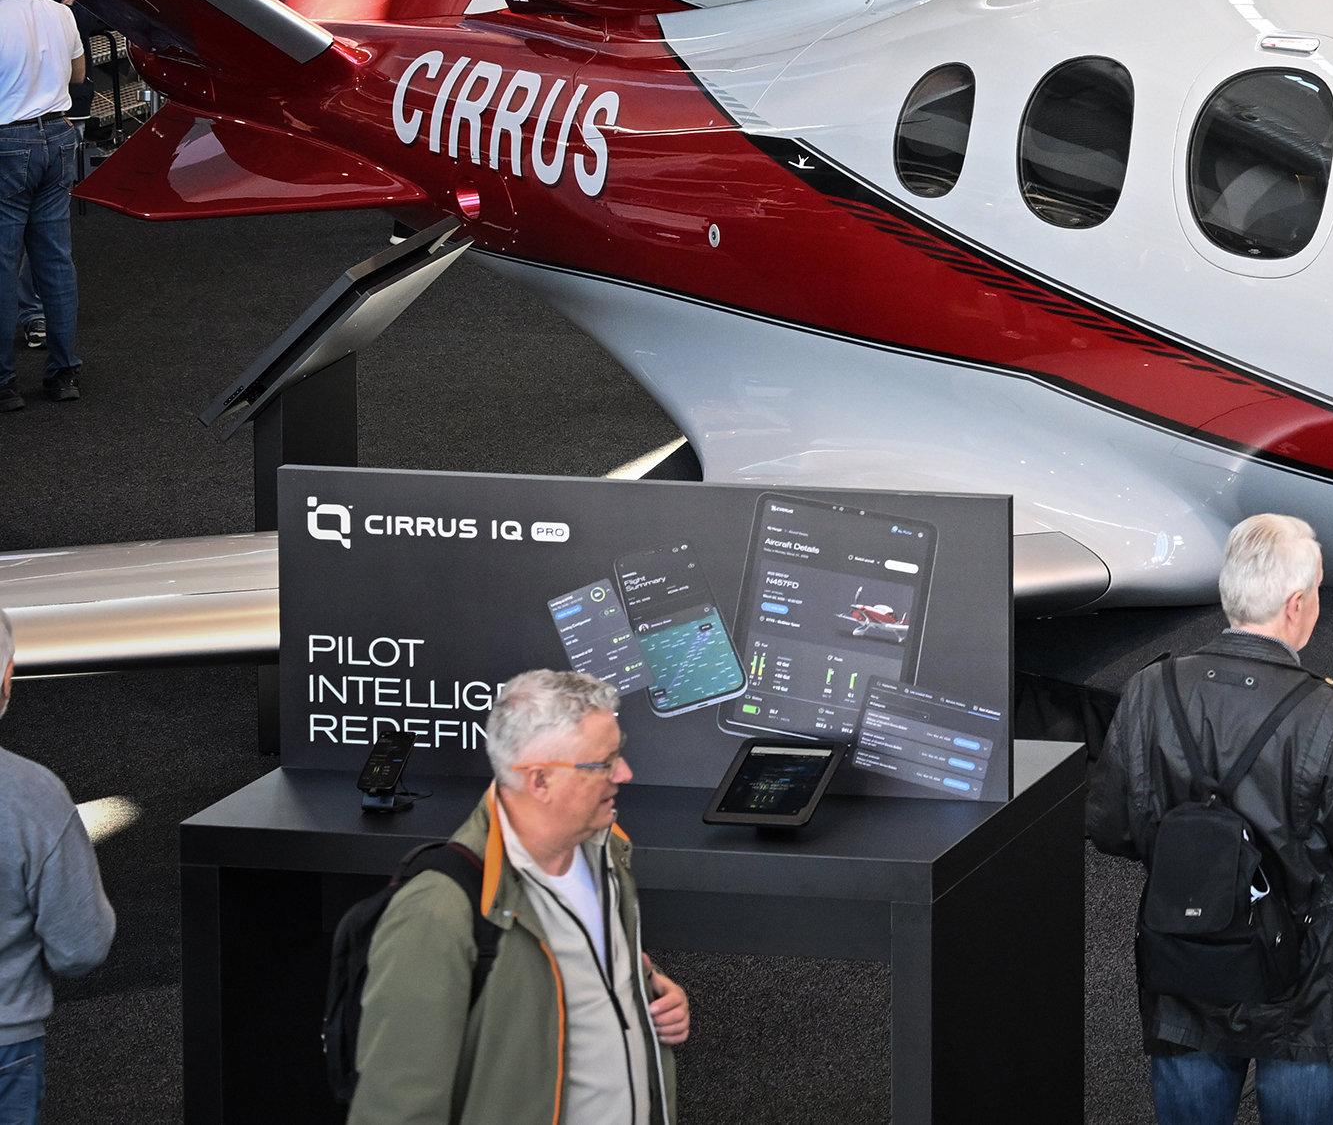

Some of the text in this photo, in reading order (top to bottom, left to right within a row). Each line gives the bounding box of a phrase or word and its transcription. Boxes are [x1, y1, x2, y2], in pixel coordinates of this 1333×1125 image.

[392, 50, 620, 197] CIRRUS
[364, 515, 565, 541] CIRRUS IQ PRO
[764, 537, 793, 550] Aircraft
[793, 542, 820, 554] Details
[623, 575, 646, 587] Flight
[625, 575, 666, 592] Summary
[765, 577, 799, 589] N457FD
[308, 635, 425, 667] PILOT
